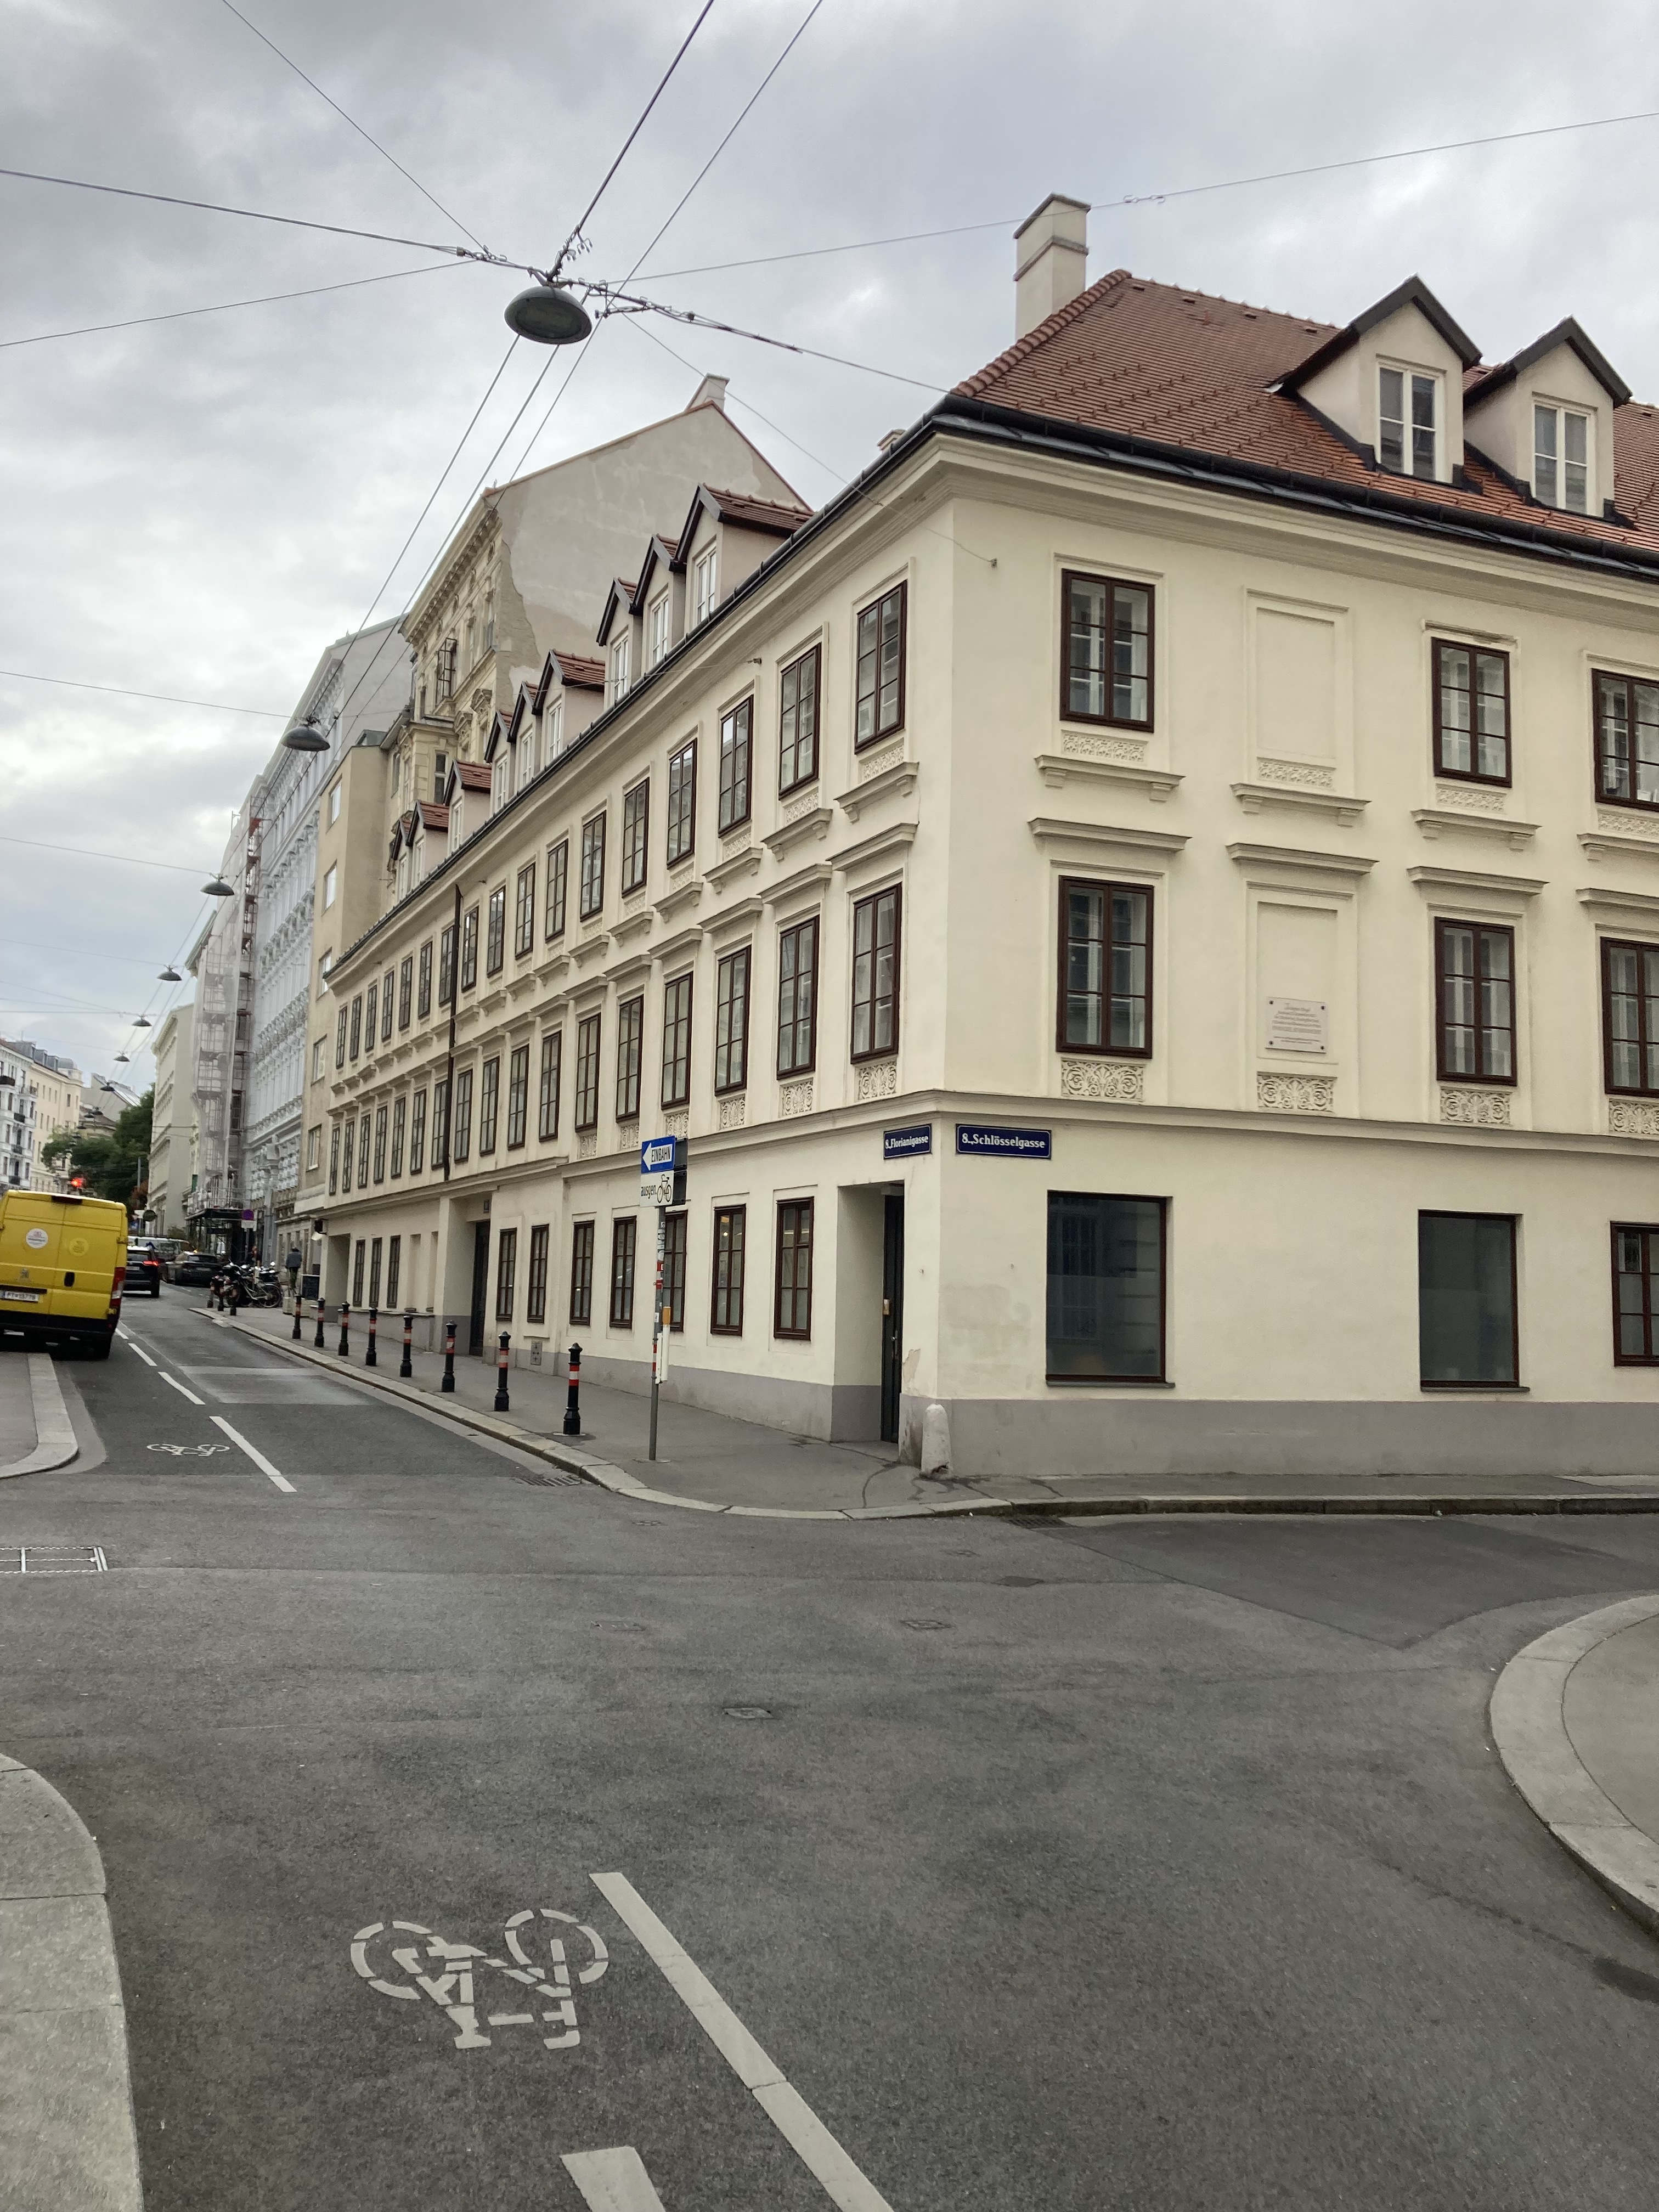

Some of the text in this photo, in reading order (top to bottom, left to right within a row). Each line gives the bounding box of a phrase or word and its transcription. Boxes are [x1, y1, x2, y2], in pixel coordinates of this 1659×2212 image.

[890, 1136, 929, 1148] Florianigasse
[973, 1133, 1045, 1149] Schlösselgasse
[651, 1146, 671, 1163] EINBAHN
